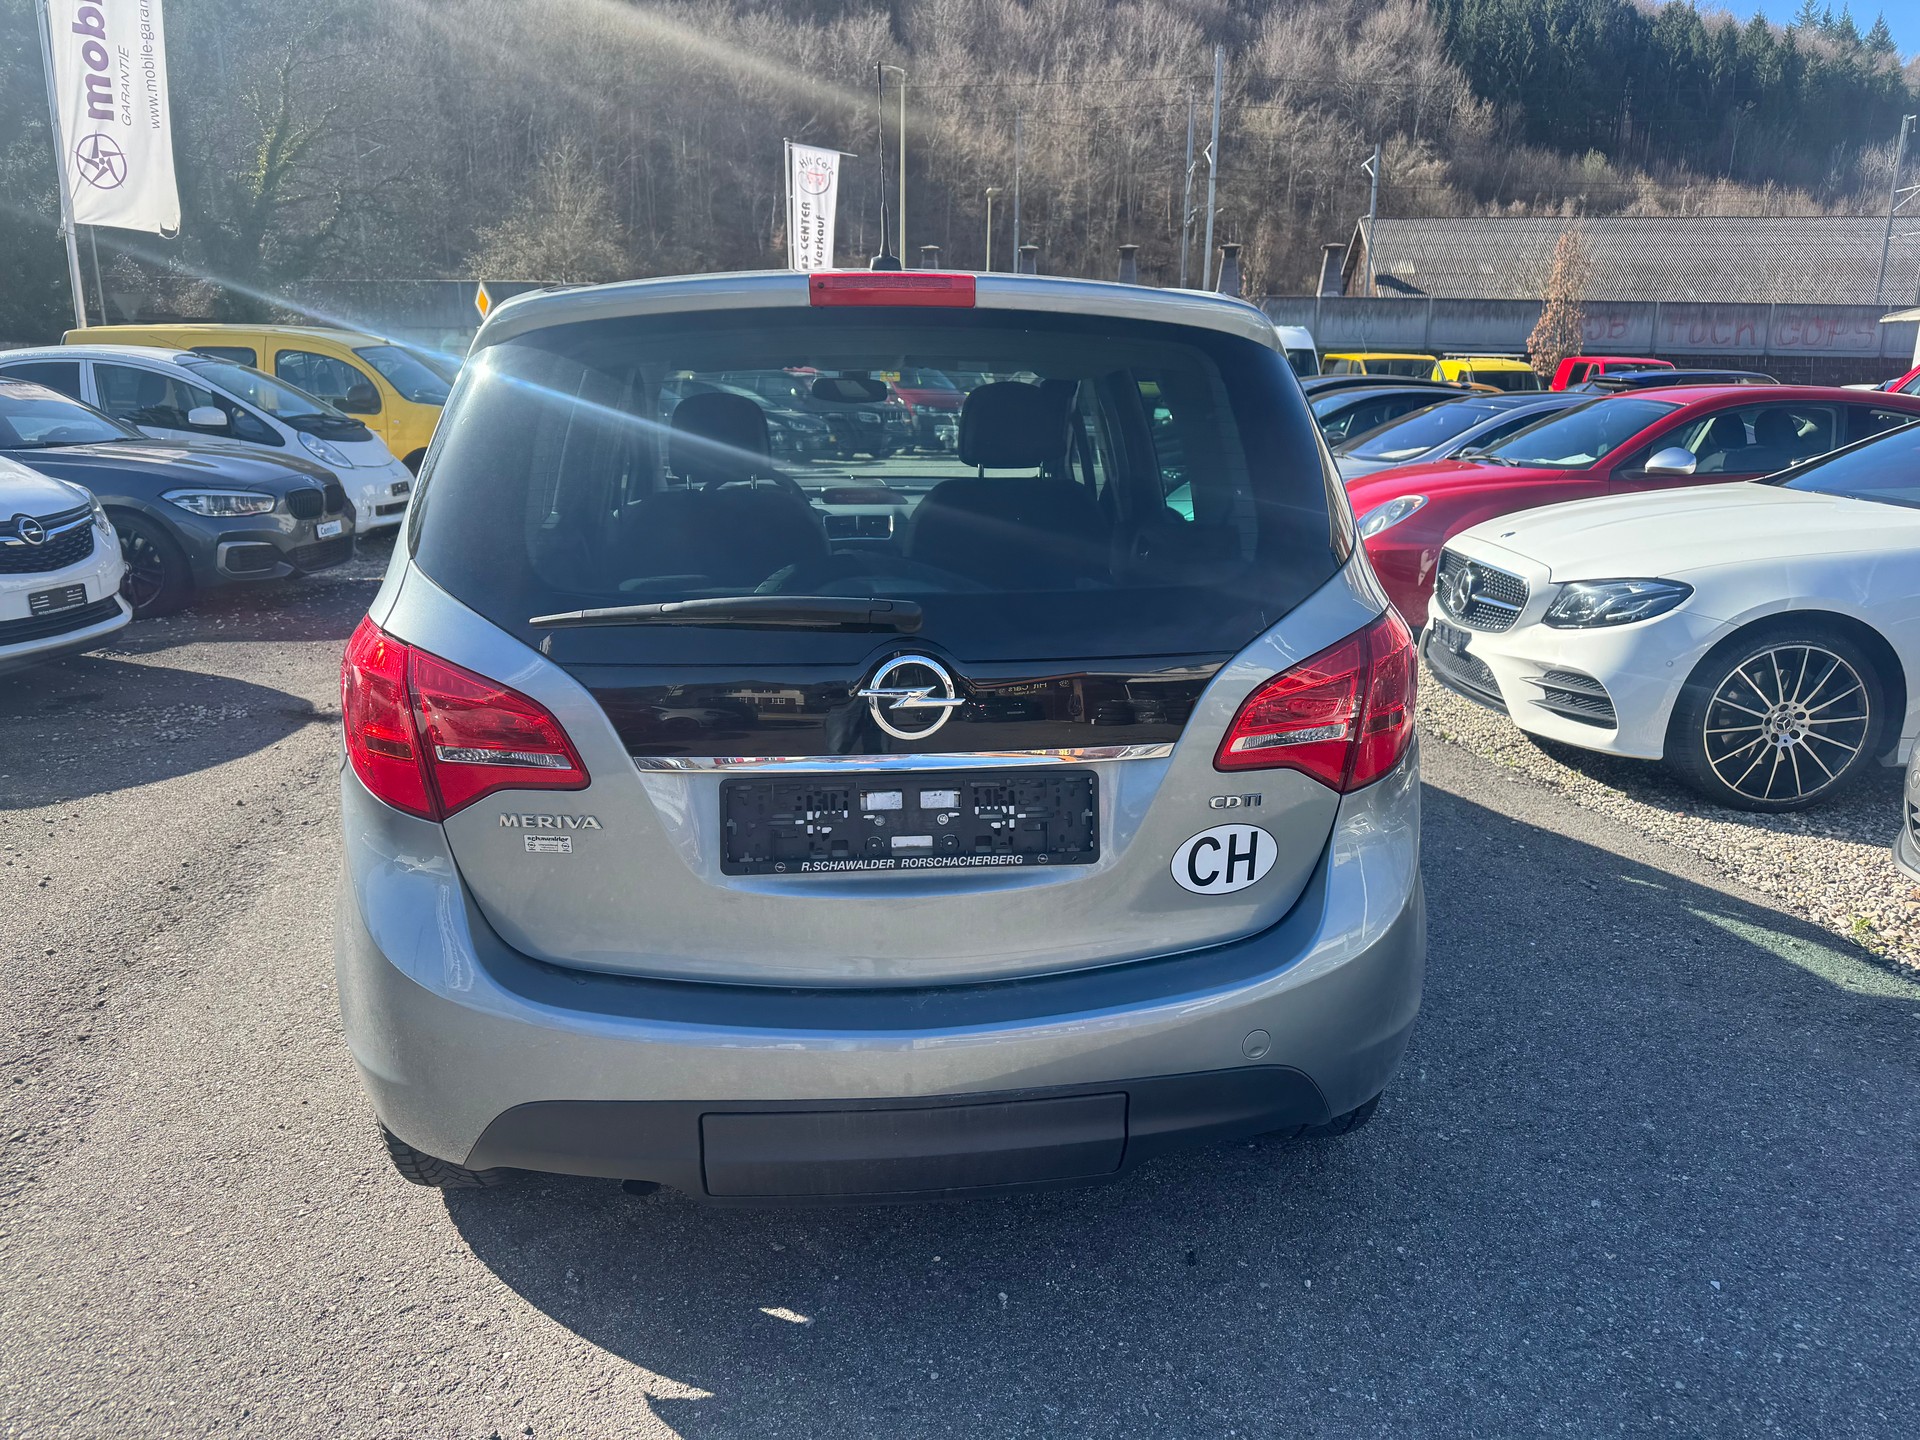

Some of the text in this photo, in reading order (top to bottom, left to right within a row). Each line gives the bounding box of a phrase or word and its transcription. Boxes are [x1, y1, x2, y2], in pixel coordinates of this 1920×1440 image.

[117, 45, 132, 127] GARANTIE
[800, 202, 811, 250] CENTER
[814, 214, 825, 268] Verkauf
[499, 813, 603, 830] MERIVA
[1209, 793, 1262, 810] CDTI
[801, 854, 1024, 872] R.SCHAWALDER RORSCHACHERBERG
[1187, 830, 1259, 887] CH
